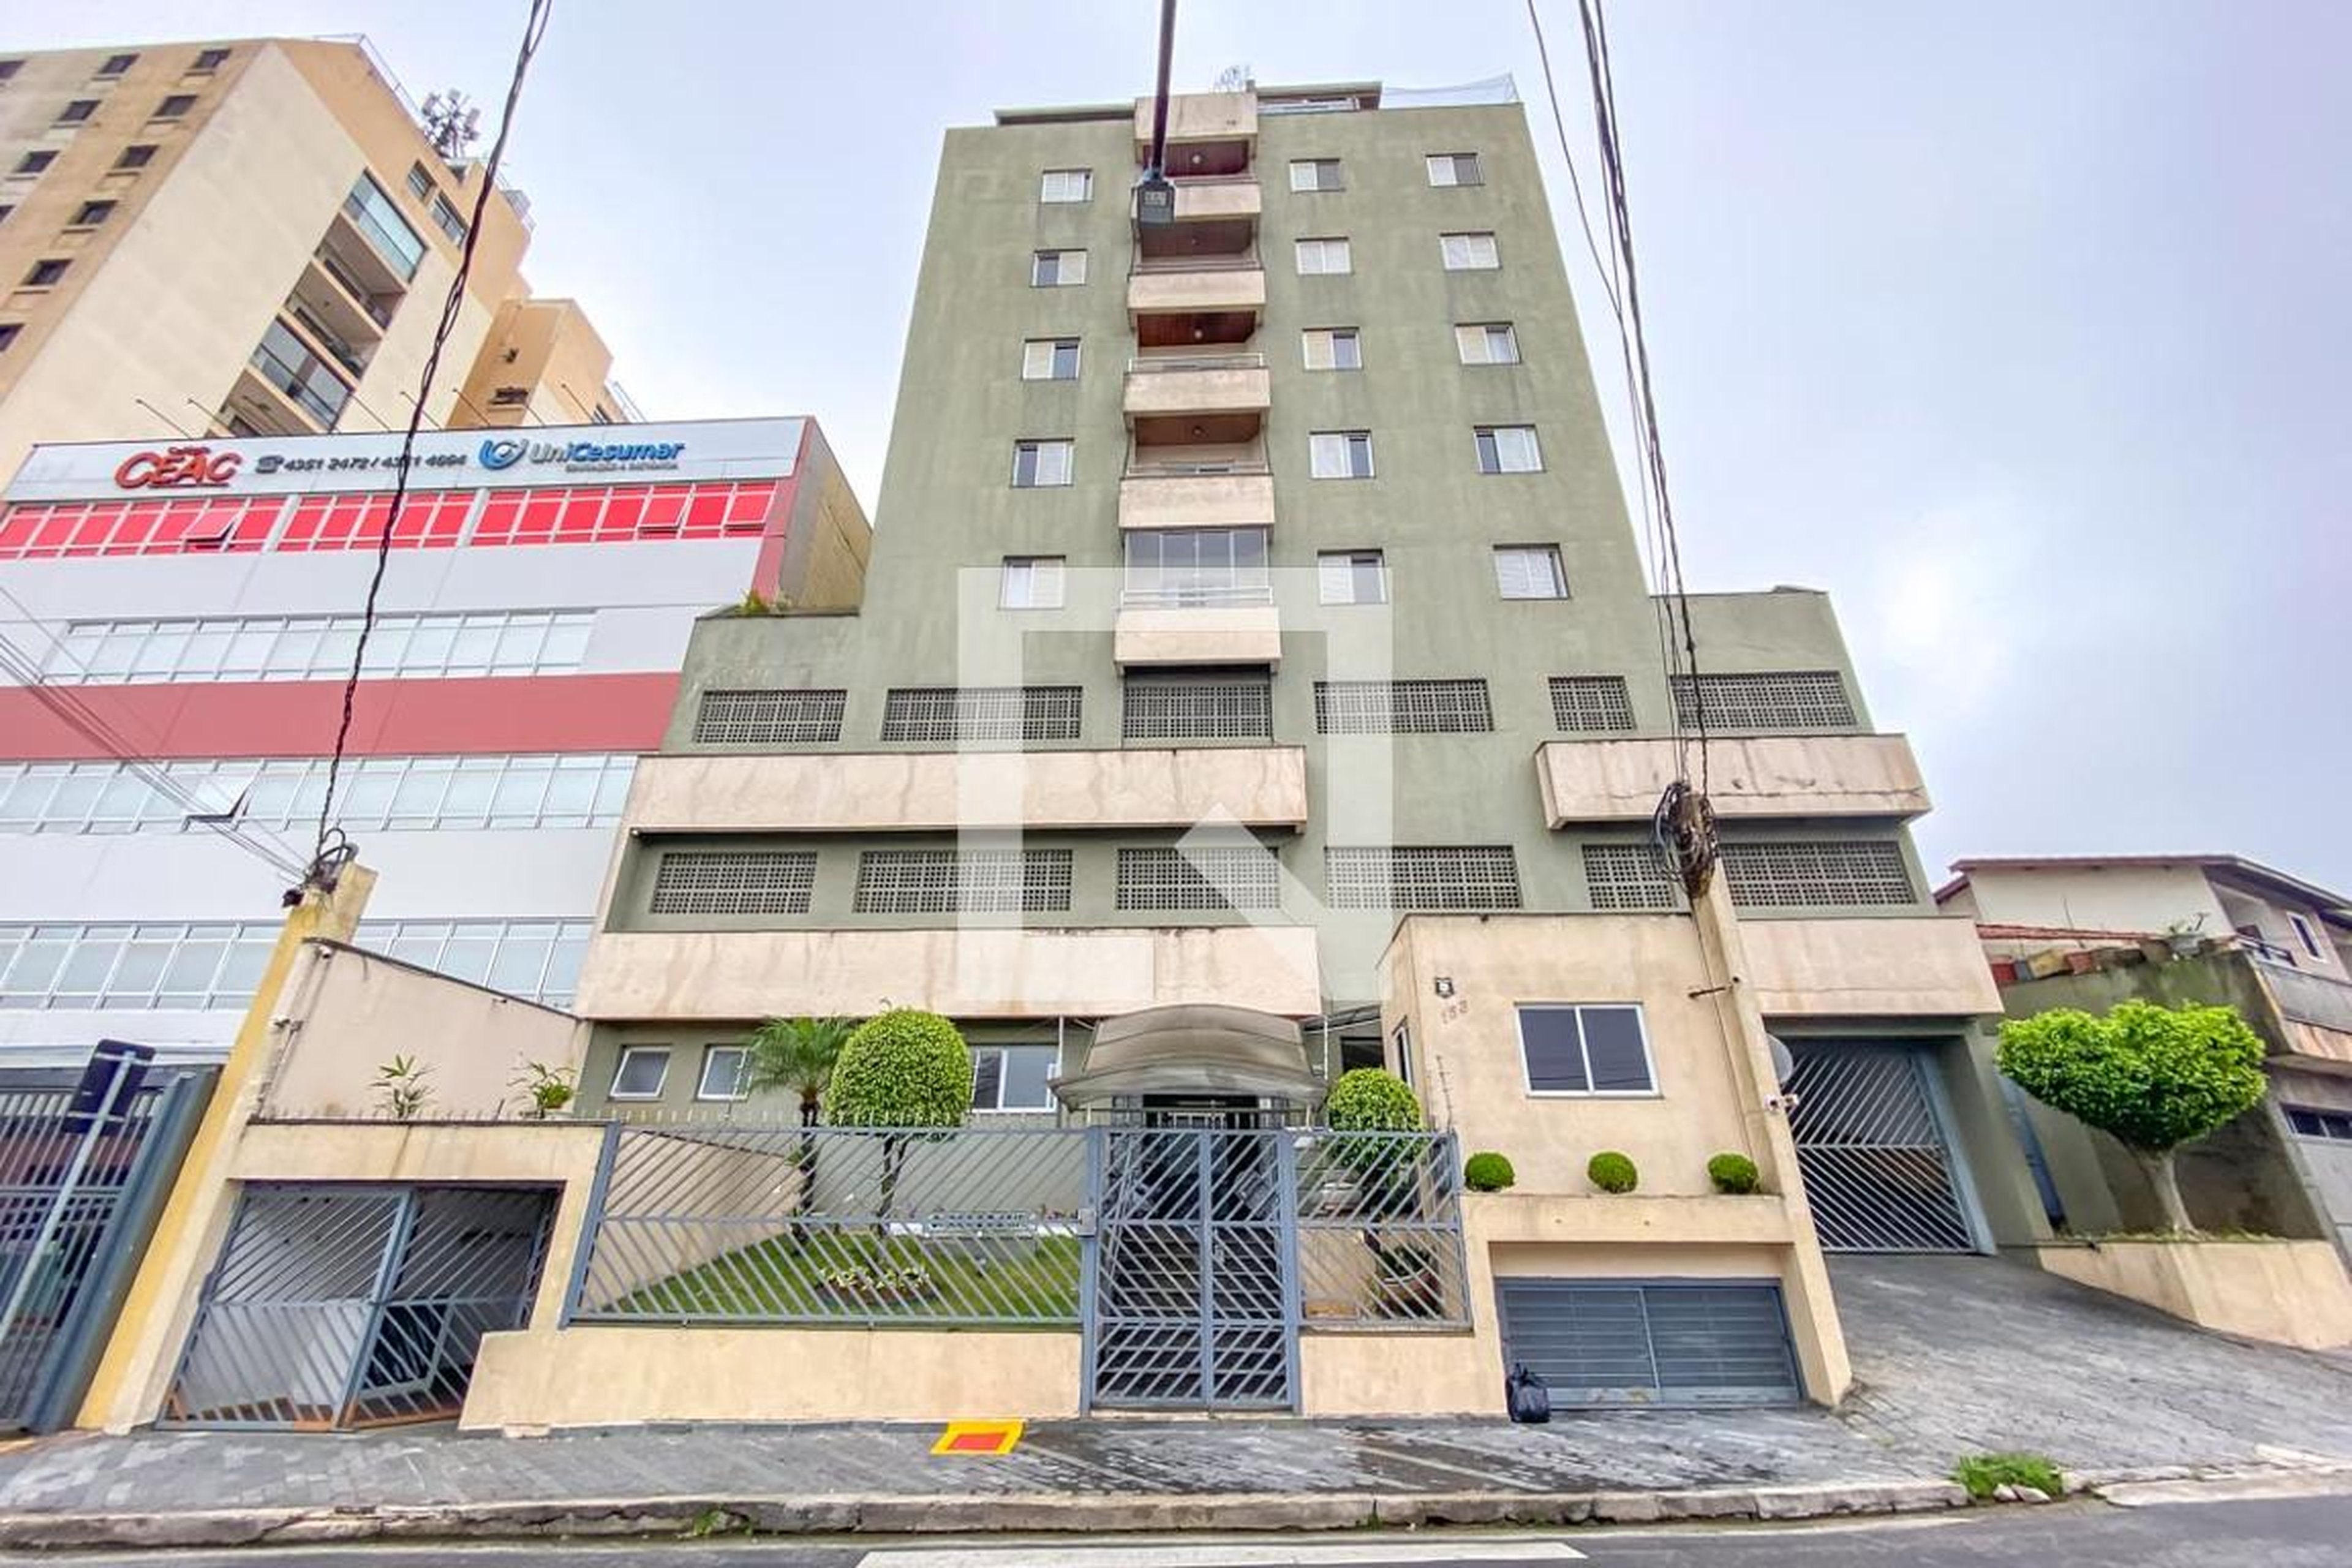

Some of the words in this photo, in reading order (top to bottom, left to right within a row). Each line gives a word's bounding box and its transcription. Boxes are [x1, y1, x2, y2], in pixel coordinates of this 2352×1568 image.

[381, 456, 423, 469] 431
[530, 442, 685, 464] UniCesumar
[115, 452, 242, 489] CEAC
